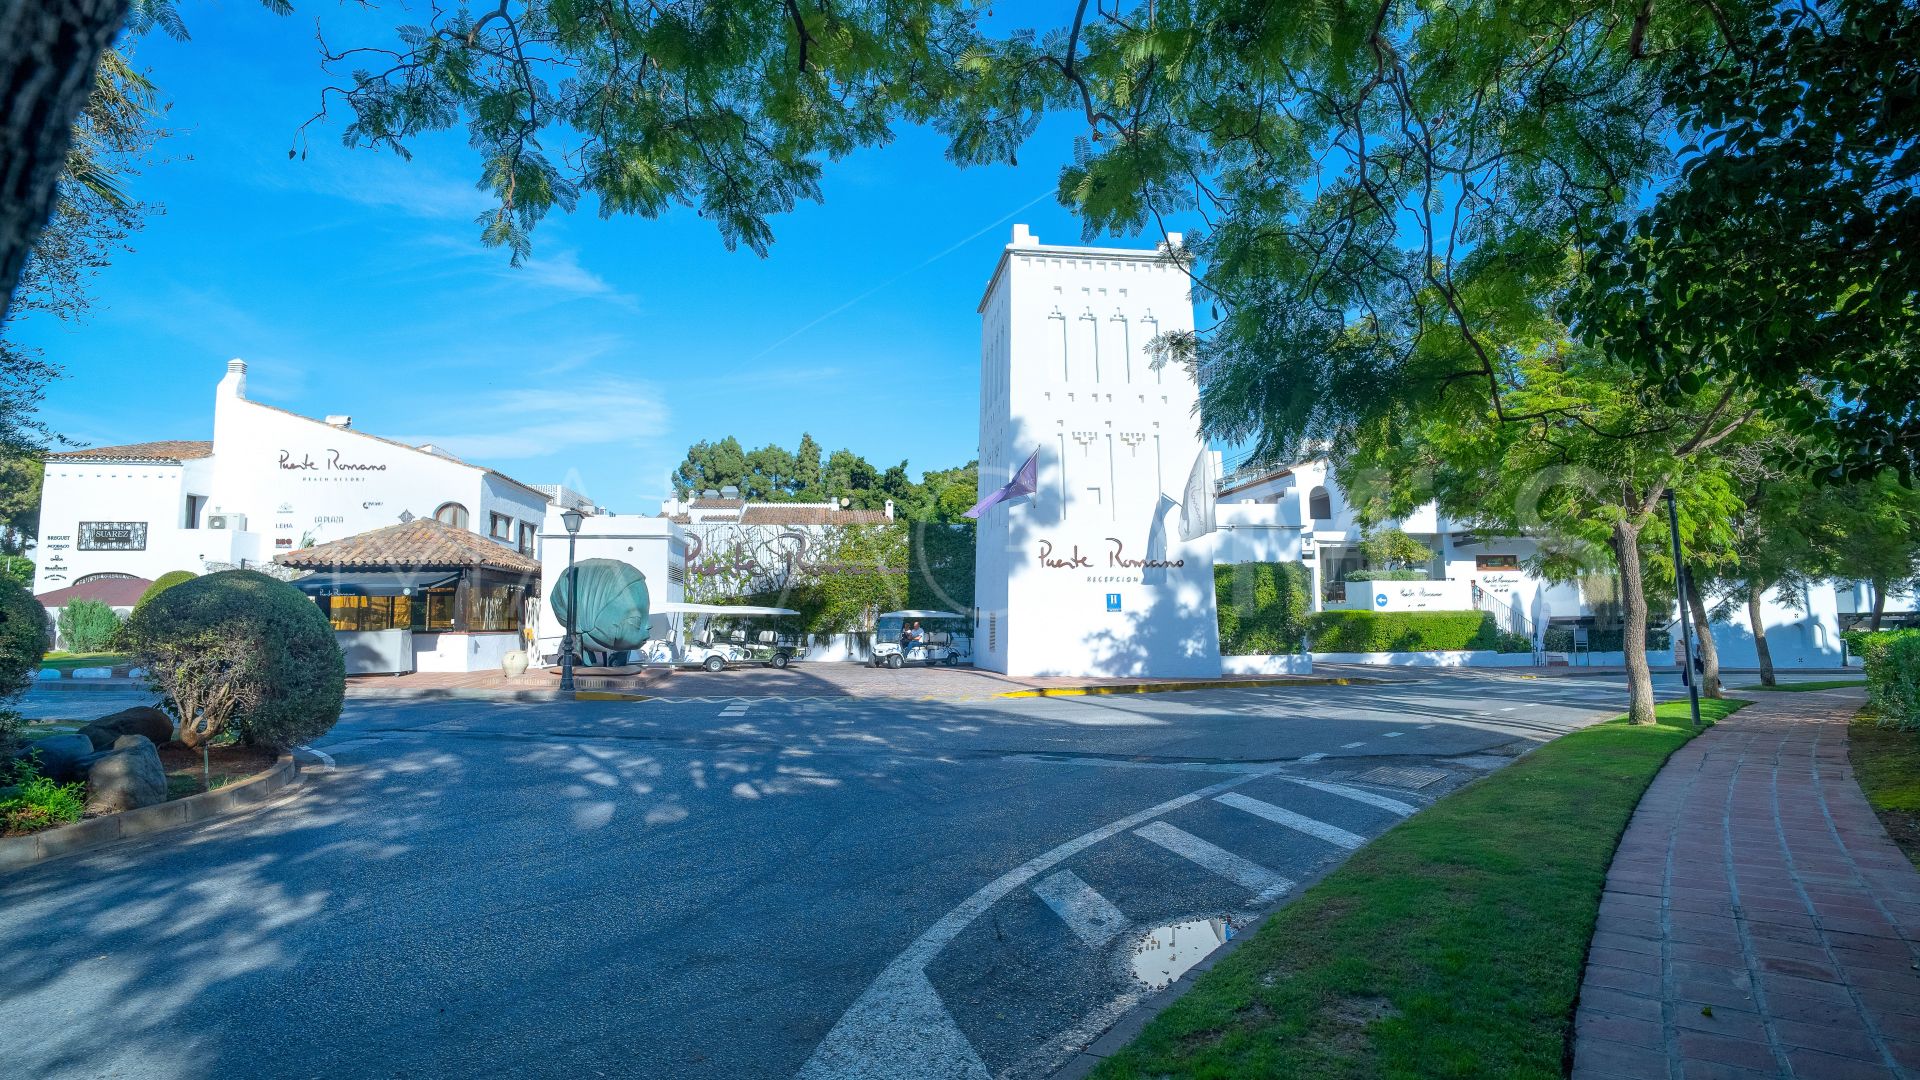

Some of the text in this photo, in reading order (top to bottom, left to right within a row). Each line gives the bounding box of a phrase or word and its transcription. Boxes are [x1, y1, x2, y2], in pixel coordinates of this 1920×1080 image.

[278, 448, 387, 471] Puente Romano
[95, 530, 129, 538] SUAREZ
[1038, 537, 1185, 570] Puente Romano
